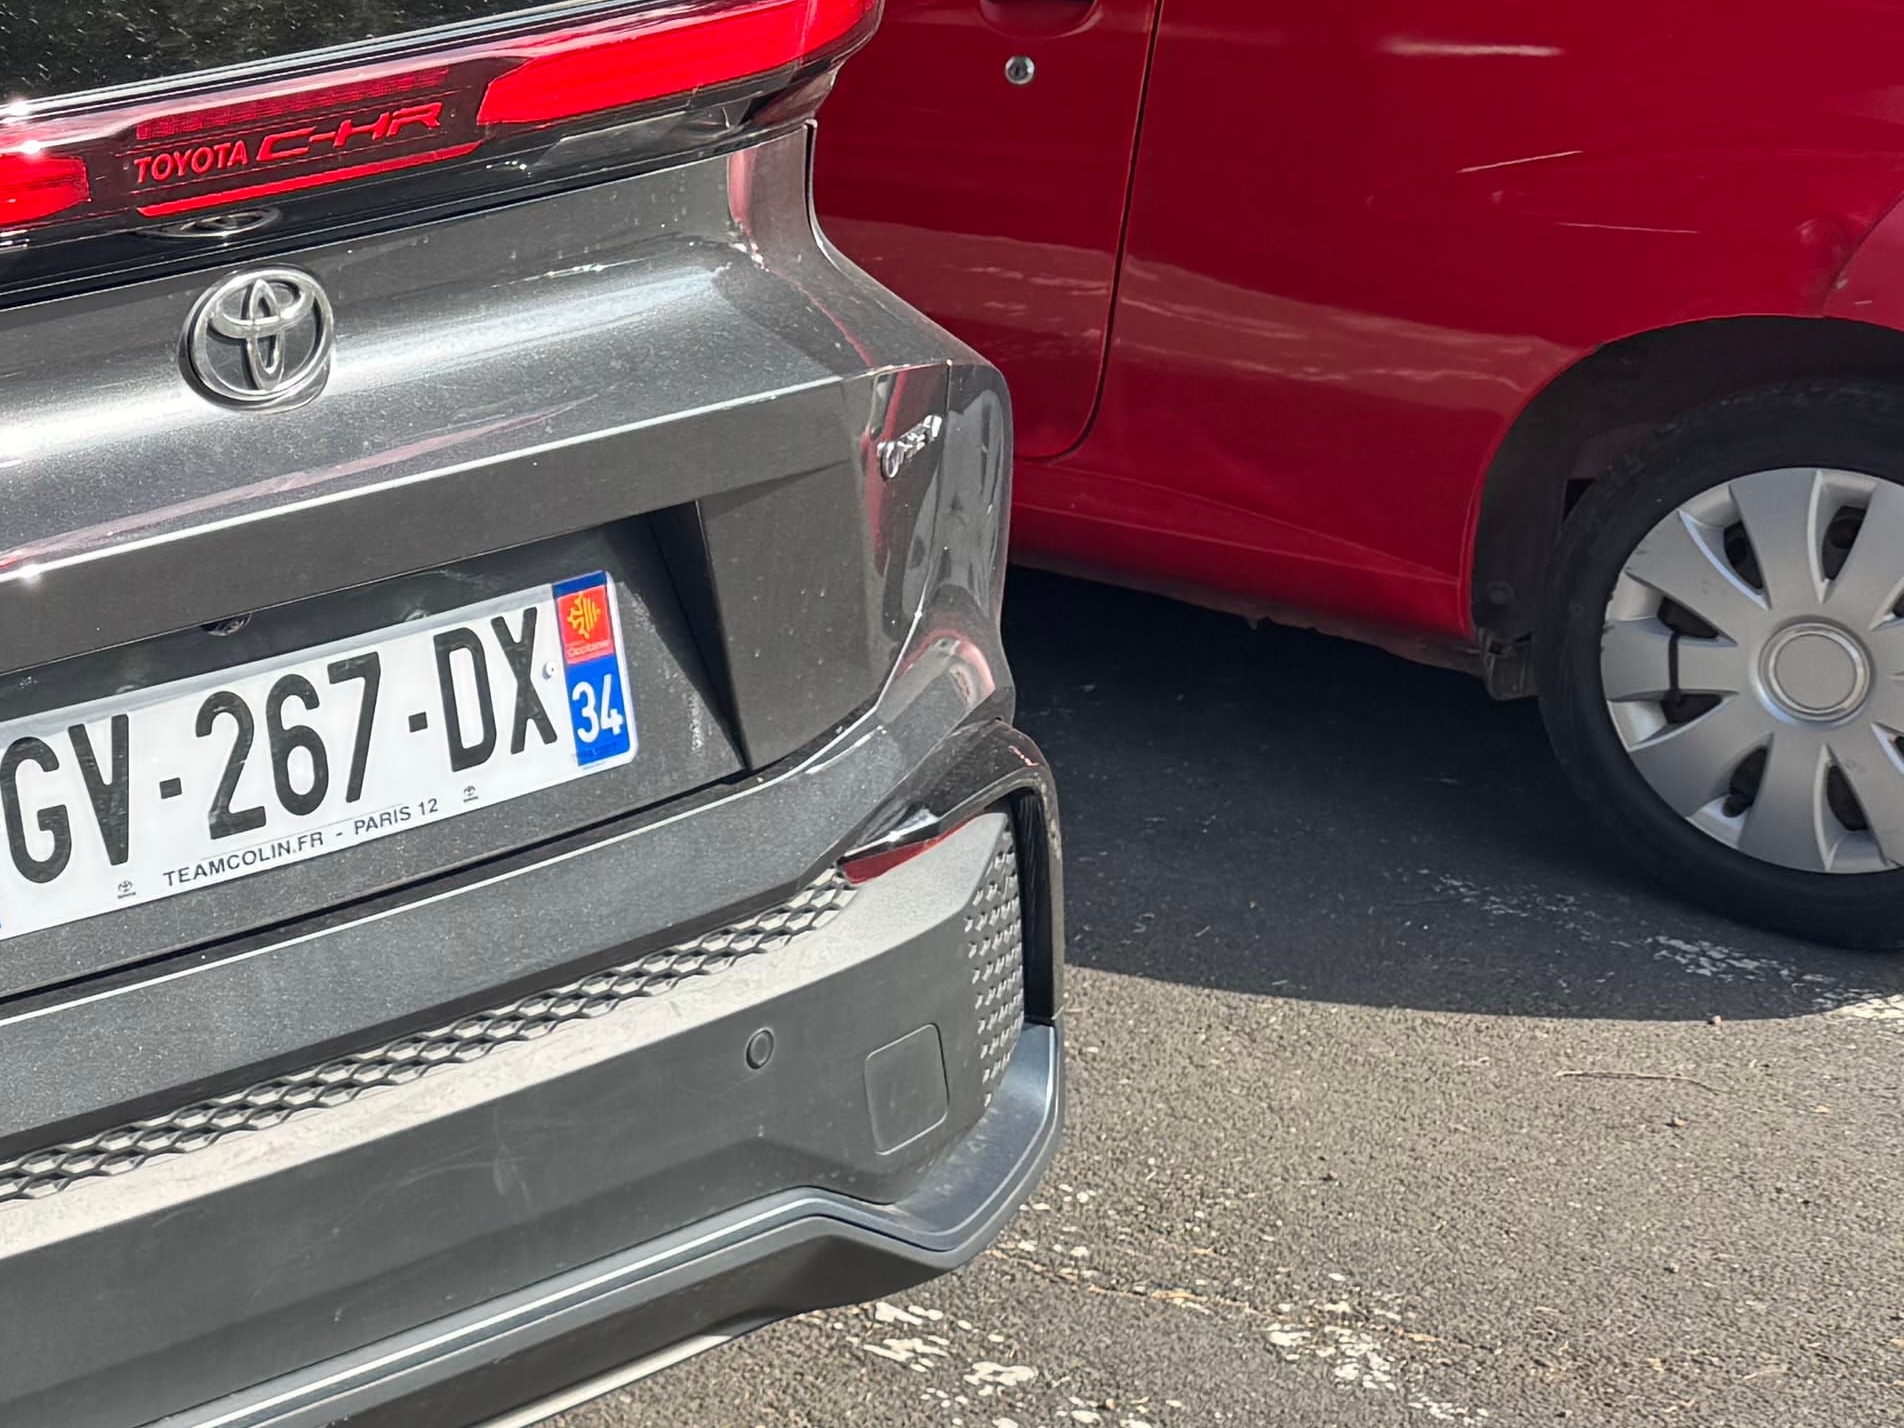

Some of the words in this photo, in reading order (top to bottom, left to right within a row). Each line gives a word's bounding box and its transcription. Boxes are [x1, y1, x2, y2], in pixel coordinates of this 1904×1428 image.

[134, 140, 248, 183] TOYOTA
[256, 102, 442, 162] C-HR
[571, 673, 624, 743] 34
[163, 831, 324, 887] TEAMCOLIN.FR
[353, 805, 412, 836] PARIS
[419, 798, 439, 816] 12
